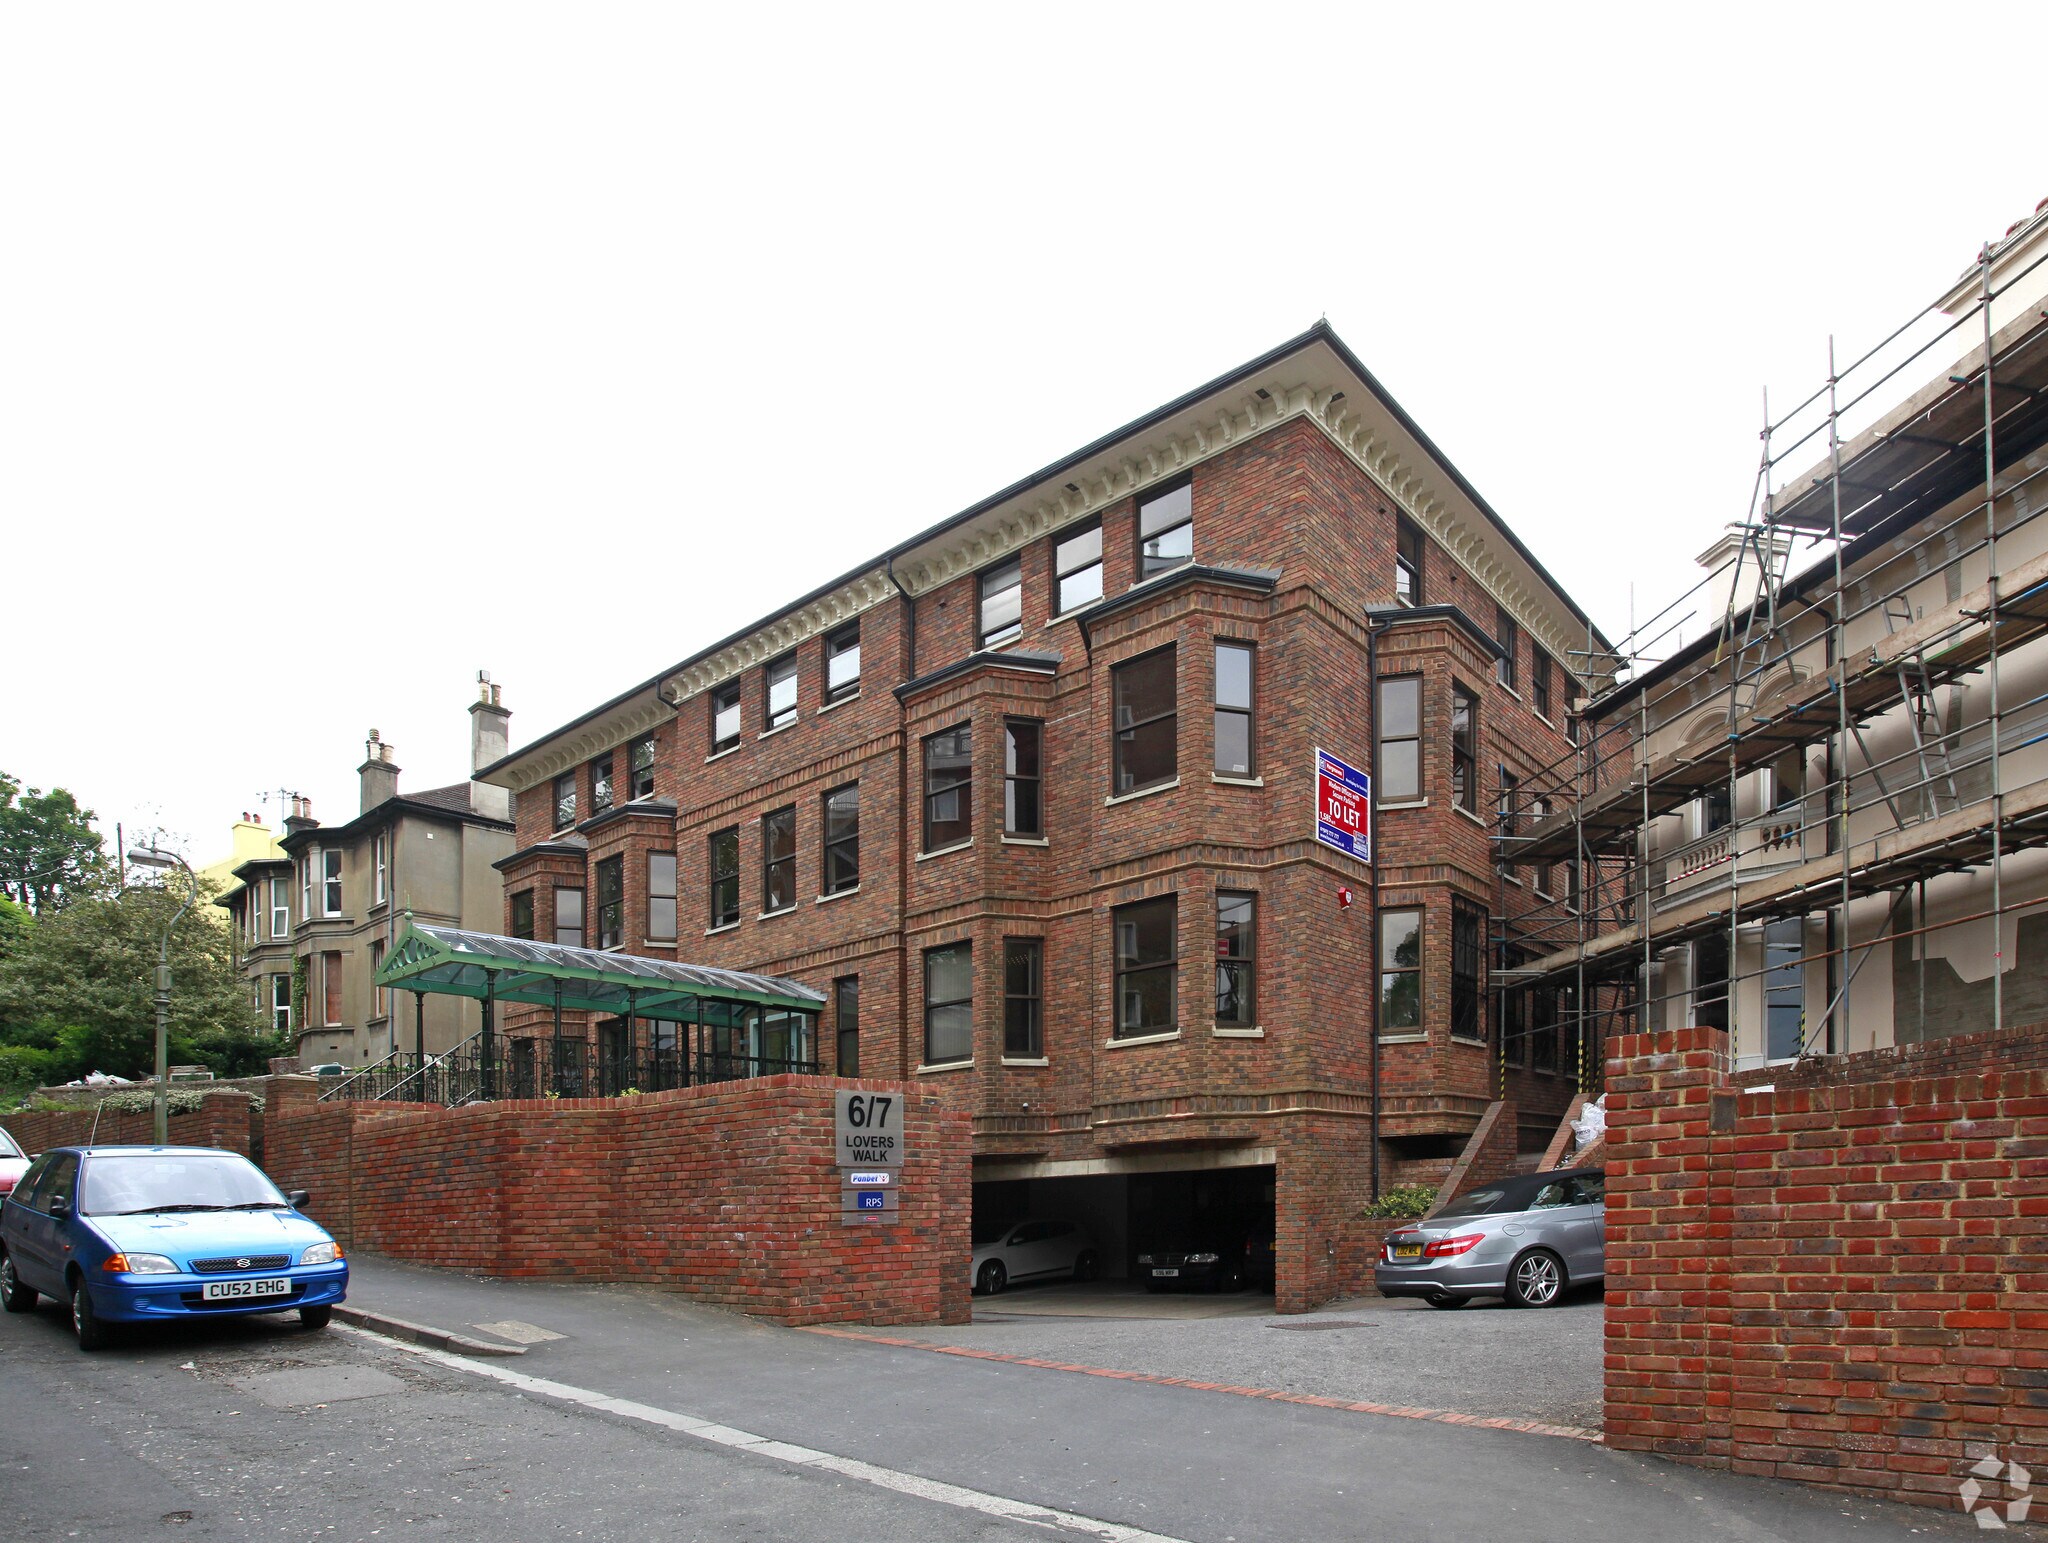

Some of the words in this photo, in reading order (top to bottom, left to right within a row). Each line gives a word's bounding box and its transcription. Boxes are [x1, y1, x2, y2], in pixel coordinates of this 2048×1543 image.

[1328, 797, 1341, 819] TO
[1344, 805, 1360, 828] LET
[848, 1095, 892, 1128] 6/7
[846, 1135, 894, 1148] LOVERS
[853, 1149, 888, 1162] WALK
[866, 1198, 882, 1207] RPS
[210, 1282, 251, 1297] CU52
[256, 1279, 285, 1293] EHG
